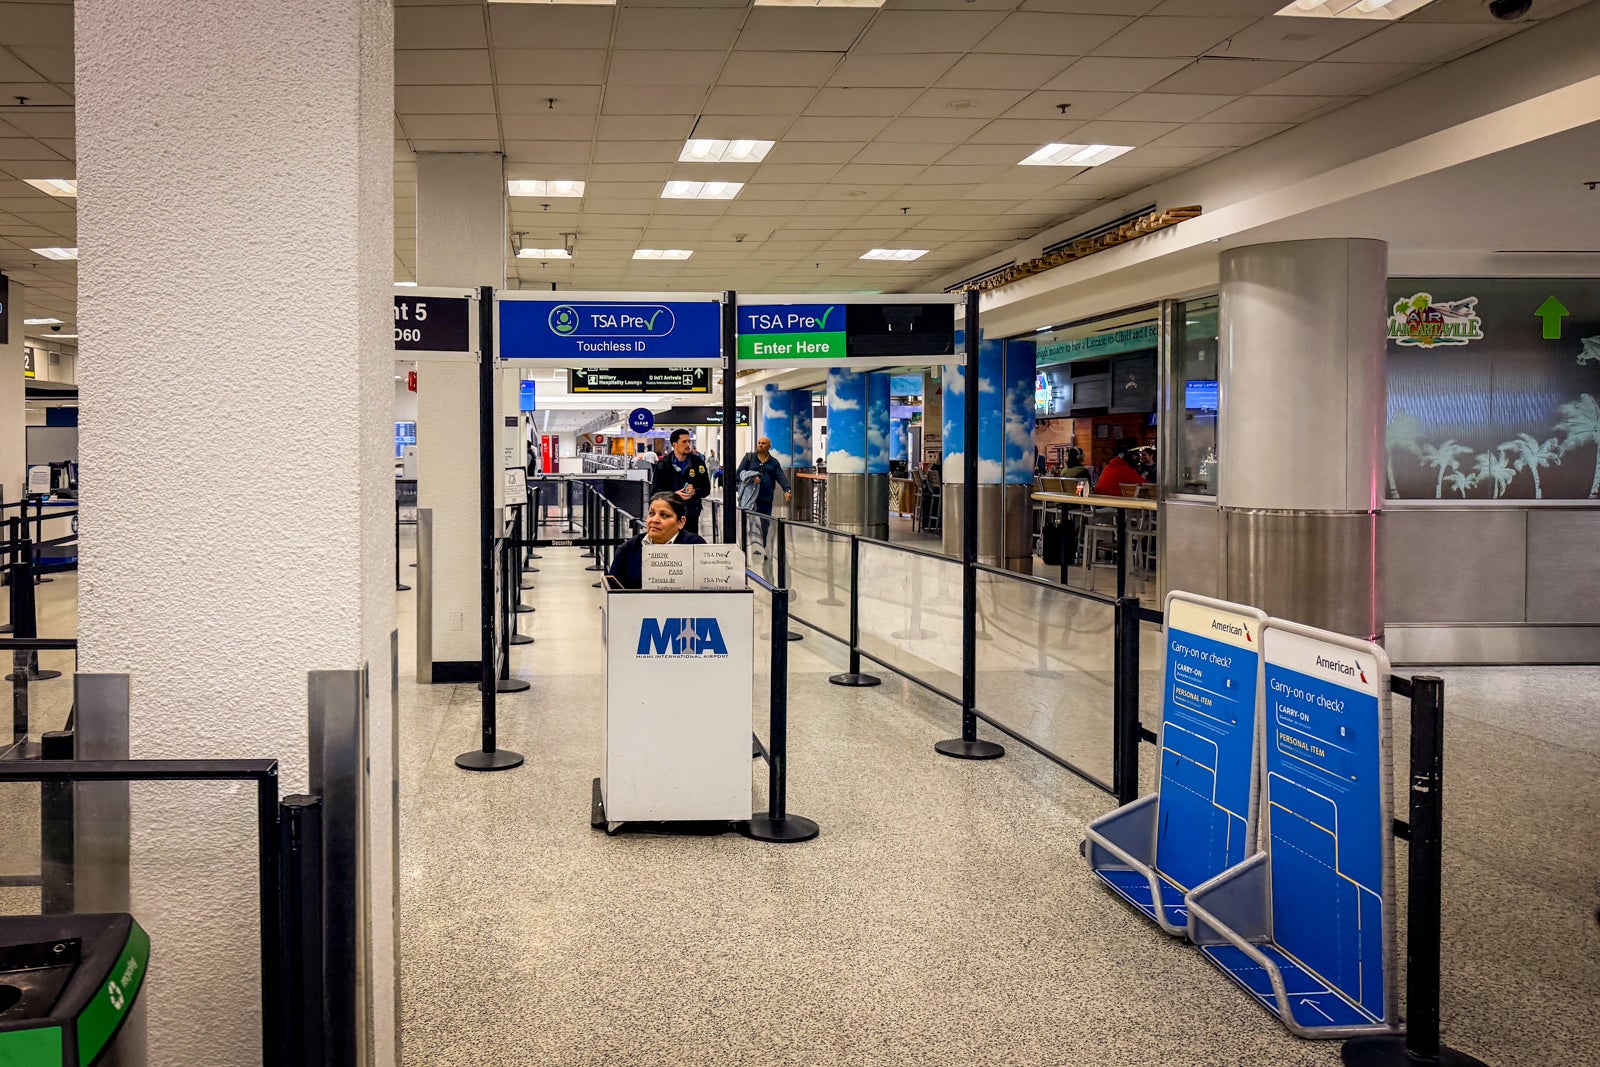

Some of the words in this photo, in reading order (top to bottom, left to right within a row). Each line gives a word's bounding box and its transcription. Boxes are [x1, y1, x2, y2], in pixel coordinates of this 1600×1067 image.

[415, 303, 427, 321] 5
[1408, 313, 1440, 322] AIR
[591, 315, 617, 328] TSA
[748, 314, 783, 329] TSA
[394, 328, 420, 342] D60
[576, 341, 632, 351] Touchless
[635, 341, 646, 351] ID
[754, 342, 793, 354] Enter
[796, 341, 830, 353] Here
[637, 618, 728, 654] MIA
[1211, 619, 1243, 636] American
[1171, 641, 1200, 659] Carry-on
[1200, 651, 1209, 661] or
[1209, 654, 1232, 668] check?
[1176, 663, 1203, 678] CARRY-ON
[1316, 655, 1355, 677] American
[1175, 687, 1200, 702] PERSONAL
[1200, 696, 1213, 707] ITEM
[1270, 678, 1305, 700] Carry-on
[1305, 690, 1315, 703] or
[1316, 693, 1345, 713] check?
[1278, 704, 1310, 722] CARRY-ON
[1279, 732, 1309, 752] PERSONAL
[1310, 744, 1325, 758] ITEM
